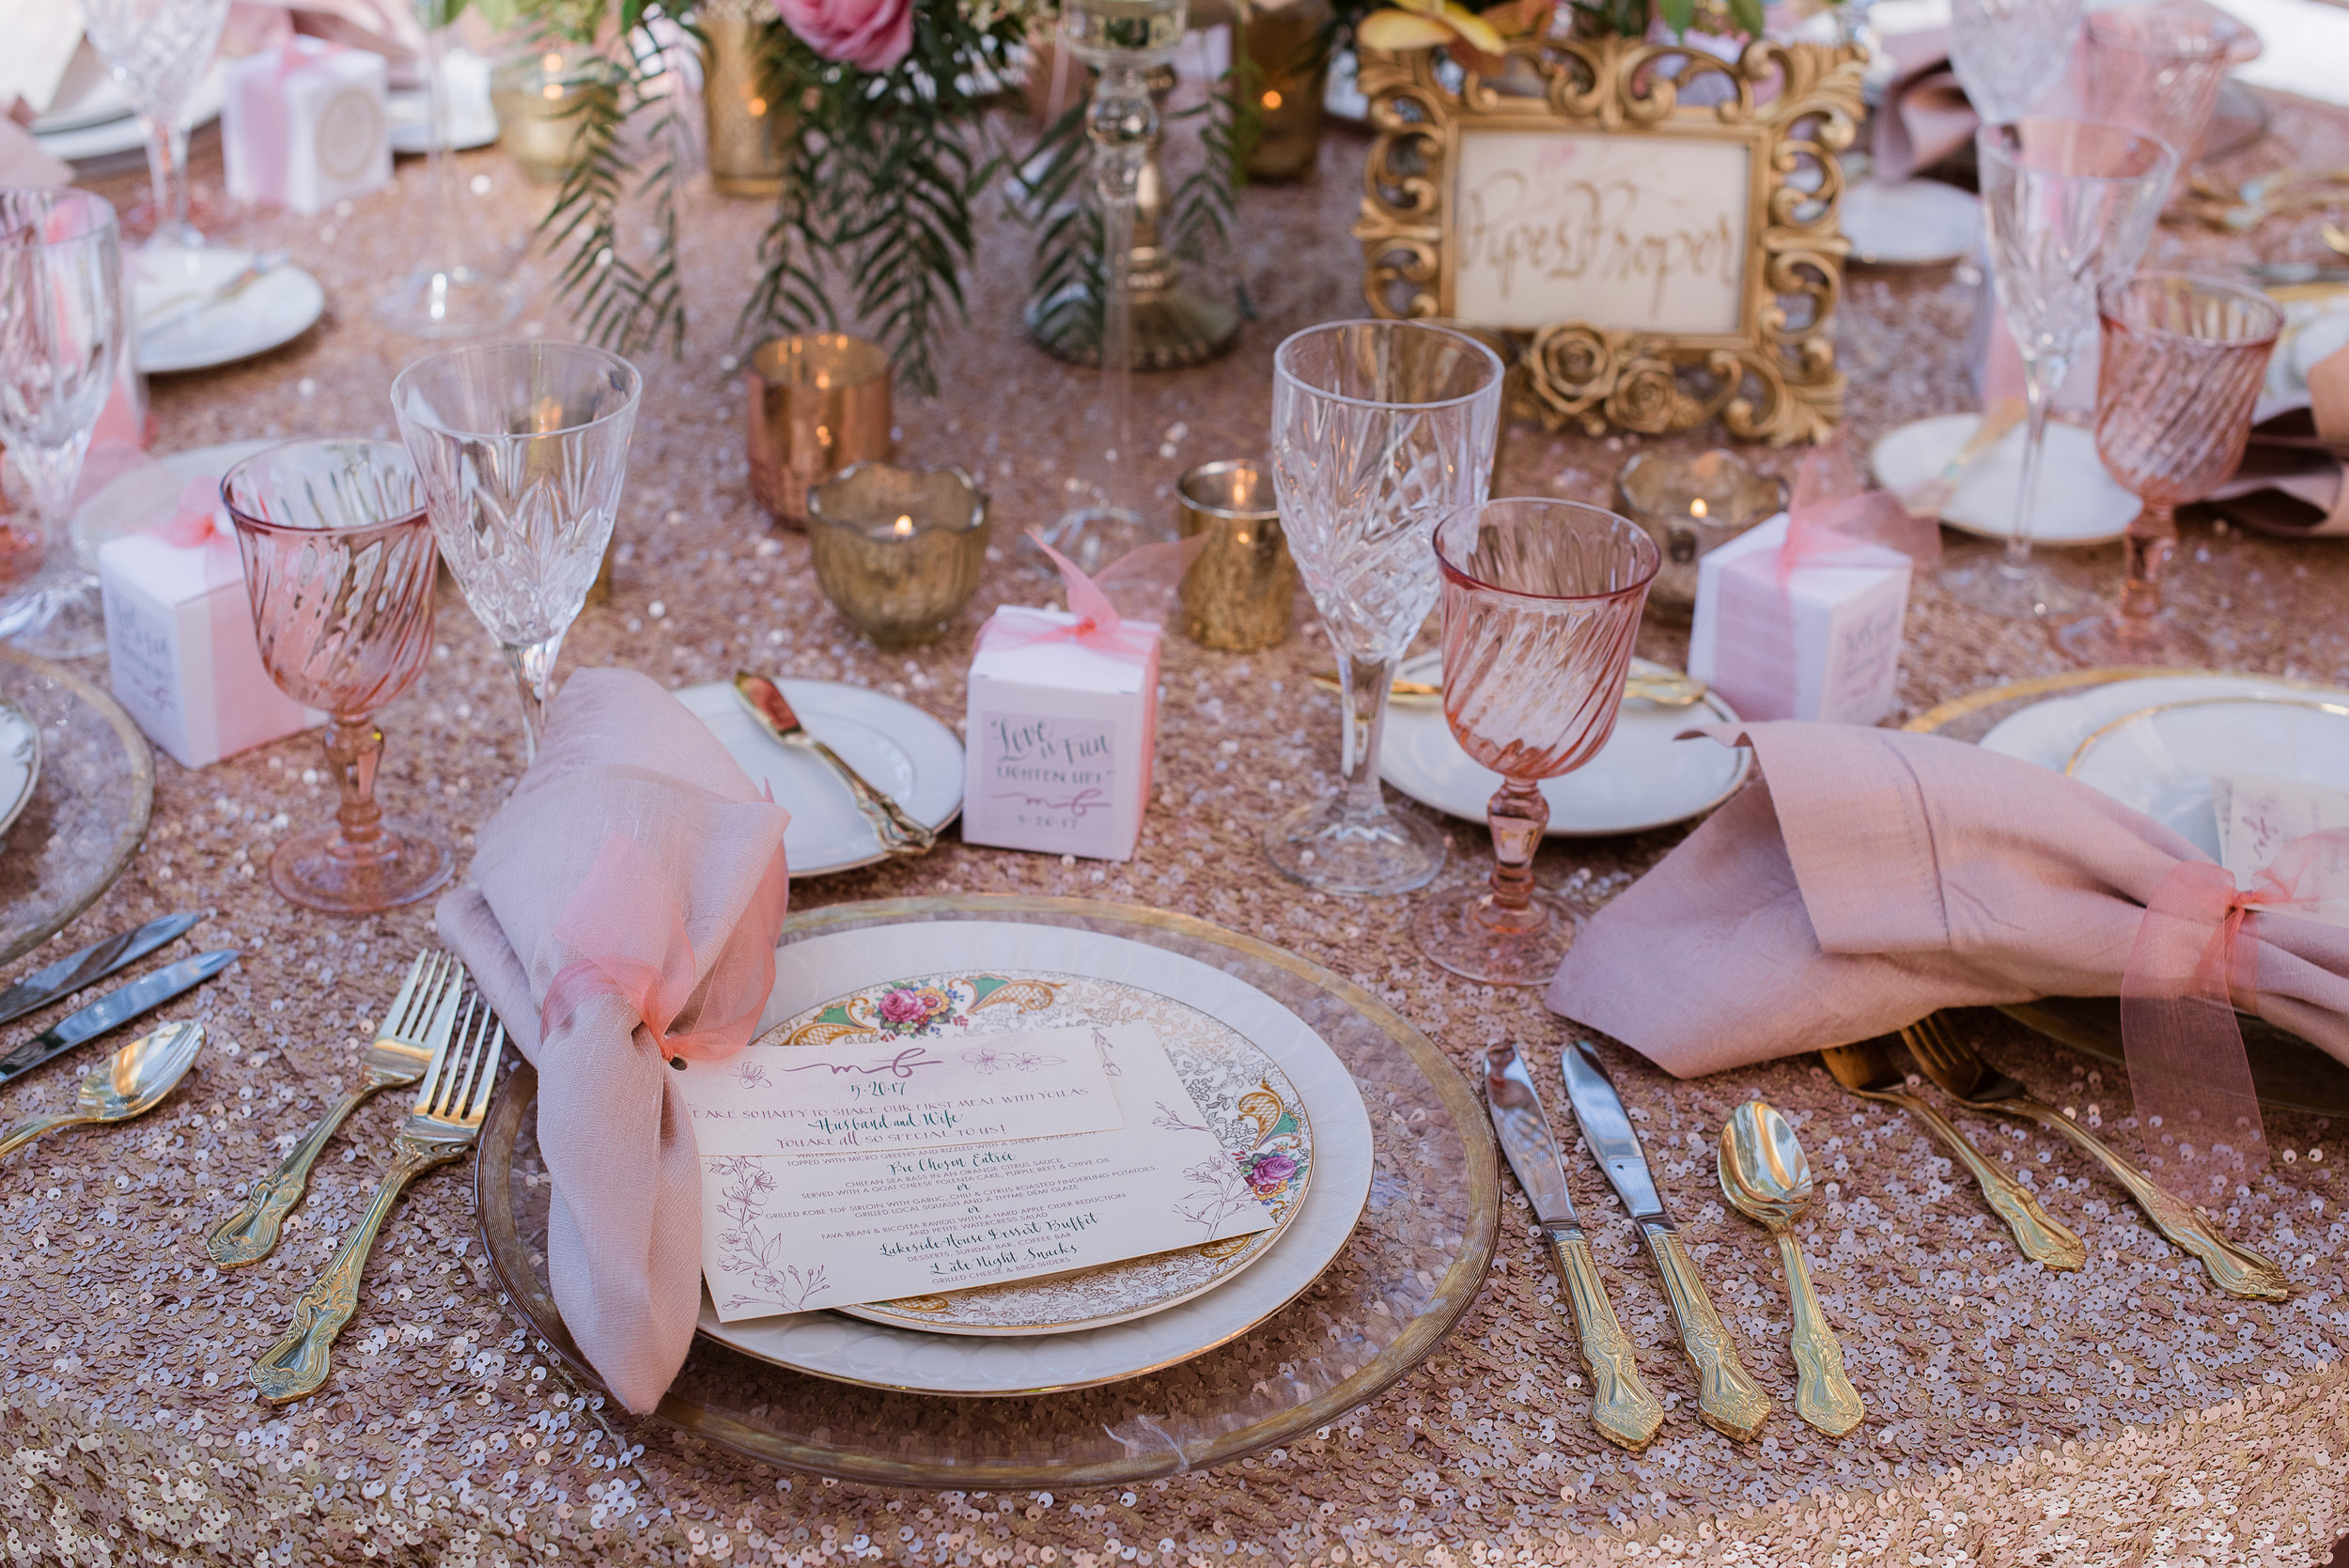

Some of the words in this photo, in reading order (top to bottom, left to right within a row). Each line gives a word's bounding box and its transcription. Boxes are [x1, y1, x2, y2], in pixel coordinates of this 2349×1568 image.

[705, 1109, 735, 1119] ARE
[742, 1110, 759, 1119] SO
[762, 1109, 805, 1120] HAPPY
[812, 1109, 828, 1117] TO
[832, 1106, 878, 1116] SHARE
[883, 1104, 913, 1113] OUR
[915, 1100, 952, 1110] FIRST
[1001, 1093, 1034, 1104] WITH
[1037, 1090, 1066, 1099] YOU
[1070, 1087, 1089, 1095] AS
[775, 1137, 804, 1149] YOU
[806, 1138, 833, 1147] ARE
[839, 1129, 861, 1147] all
[864, 1135, 883, 1143] SO
[888, 1129, 954, 1141] SPECIAL
[956, 1127, 974, 1137] TO
[807, 1113, 889, 1136] Husband
[893, 1111, 917, 1128] and
[921, 1109, 963, 1129] Wife
[786, 1157, 820, 1167] TOPPED
[821, 1155, 847, 1164] WITH
[848, 1154, 879, 1163] MICRO
[879, 1151, 916, 1159] GREENS
[918, 1148, 939, 1157] AND
[975, 1141, 999, 1150] WITH
[1010, 1136, 1040, 1146] SHERRY
[886, 1160, 915, 1176] Pre
[918, 1157, 965, 1173] Chosen
[801, 1190, 834, 1200] SERVED
[835, 1188, 860, 1196] WITH
[872, 1184, 897, 1192] GOAT
[899, 1180, 933, 1189] CHEESE
[935, 1175, 975, 1186] POLENTA
[976, 1172, 1003, 1181] CAKE,
[1004, 1168, 1035, 1176] PURPLE
[1036, 1164, 1056, 1172] BEET
[1067, 1159, 1093, 1168] CHIVE
[845, 1179, 884, 1188] CHILEAN
[905, 1173, 927, 1182] BASS
[958, 1165, 998, 1175] ORANGE
[1000, 1161, 1031, 1171] CITRUS
[1032, 1157, 1062, 1167] SAUCE
[956, 1181, 971, 1192] or
[765, 1211, 800, 1220] GRILLED
[801, 1208, 827, 1217] KOBE
[848, 1203, 884, 1212] SIRLOIN
[885, 1199, 910, 1208] WITH
[911, 1195, 948, 1205] GARLIC,
[949, 1190, 972, 1200] CHILI
[983, 1187, 1014, 1196] CITRUS
[1015, 1180, 1055, 1191] ROASTED
[1057, 1172, 1110, 1185] FINGERLING
[1111, 1165, 1159, 1177] POTATOES,
[854, 1208, 889, 1219] GRILLED
[891, 1205, 919, 1215] LOCAL
[922, 1200, 960, 1211] SQUASH
[962, 1196, 983, 1205] AND
[994, 1191, 1025, 1201] THYME
[1026, 1188, 1049, 1196] DEMI
[1050, 1184, 1080, 1193] GLAZE
[820, 1232, 844, 1240] FAVA
[845, 1229, 871, 1237] BEAN
[881, 1222, 918, 1234] RICOTTA
[921, 1218, 956, 1228] RAVIOLI
[957, 1214, 982, 1223] WITH
[993, 1209, 1019, 1218] HARD
[1020, 1205, 1045, 1214] APPLE
[1047, 1201, 1073, 1210] CIDER
[1075, 1192, 1127, 1205] REDUCTION
[909, 1229, 930, 1237] AND
[931, 1224, 959, 1234] PETITE
[959, 1216, 1018, 1230] WATERCRESS
[1019, 1211, 1049, 1221] SALAD
[967, 1204, 981, 1214] or
[879, 1235, 942, 1257] Lakeside
[941, 1233, 985, 1250] House
[988, 1220, 1042, 1242] Dessert
[1044, 1211, 1099, 1236] Buffet
[907, 1250, 954, 1263] DESSERTS,
[955, 1245, 993, 1256] SUNDAE
[994, 1241, 1016, 1250] BAR,
[1018, 1234, 1051, 1246] COFFEE
[1053, 1232, 1072, 1240] BAR
[931, 1274, 967, 1285] GRILLED
[969, 1267, 1003, 1280] CHEESE
[1015, 1263, 1034, 1271] BBQ
[1036, 1256, 1071, 1268] SLIDERS
[972, 1250, 1019, 1274] Night
[1023, 1241, 1080, 1265] Snacks
